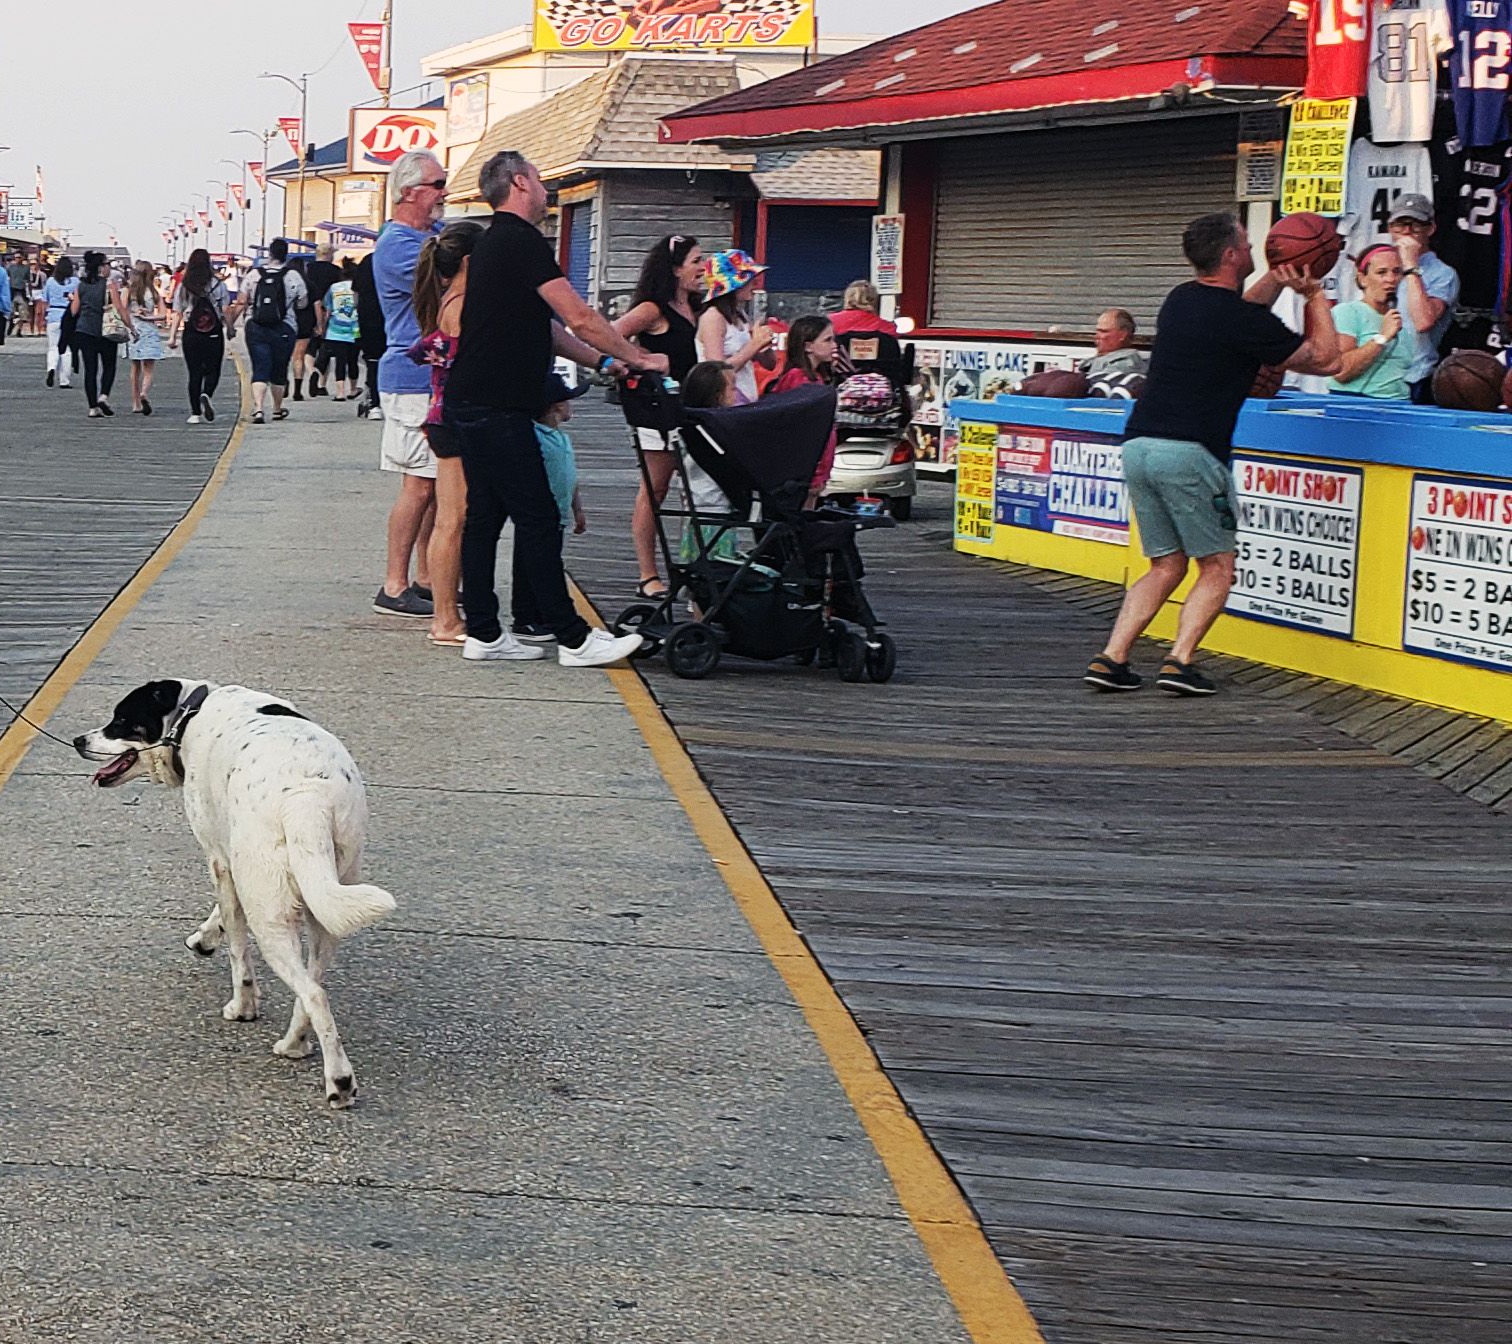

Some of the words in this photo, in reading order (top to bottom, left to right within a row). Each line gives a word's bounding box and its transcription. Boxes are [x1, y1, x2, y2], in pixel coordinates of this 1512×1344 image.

[559, 16, 627, 46] GO
[631, 12, 789, 45] KARTS
[1377, 22, 1430, 84] 81
[1458, 30, 1511, 89] 12
[371, 124, 430, 152] DQ
[1367, 164, 1408, 178] KAMARA
[1371, 188, 1403, 233] 4
[945, 349, 991, 370] FUNNEL
[995, 352, 1029, 371] CAKE
[1244, 465, 1253, 491] 3
[1049, 475, 1129, 523] CHALLEN
[1427, 486, 1438, 515] 3
[1238, 502, 1255, 528] NE
[1257, 504, 1270, 530] IN
[1274, 507, 1304, 535] WINS
[1306, 511, 1355, 543] CHOICE!
[1256, 548, 1267, 560] =
[1272, 547, 1283, 567] 2
[1289, 550, 1351, 579] BALLS
[1445, 529, 1462, 559] IN
[1465, 532, 1502, 565] WINS
[1261, 576, 1271, 588] =
[1276, 575, 1286, 595] 5
[1291, 579, 1350, 608] BALLS
[1411, 569, 1436, 593] $5
[1444, 579, 1456, 592] =
[1463, 578, 1477, 600] 2
[1249, 600, 1262, 612] One
[1265, 603, 1283, 616] Prize
[1286, 607, 1299, 619] Per
[1300, 610, 1324, 624] Game
[1409, 598, 1443, 624] $10
[1450, 610, 1462, 624] =
[1468, 609, 1480, 632] 5
[1435, 637, 1452, 650] One
[1455, 640, 1477, 656] Prize
[1480, 645, 1496, 658] Per
